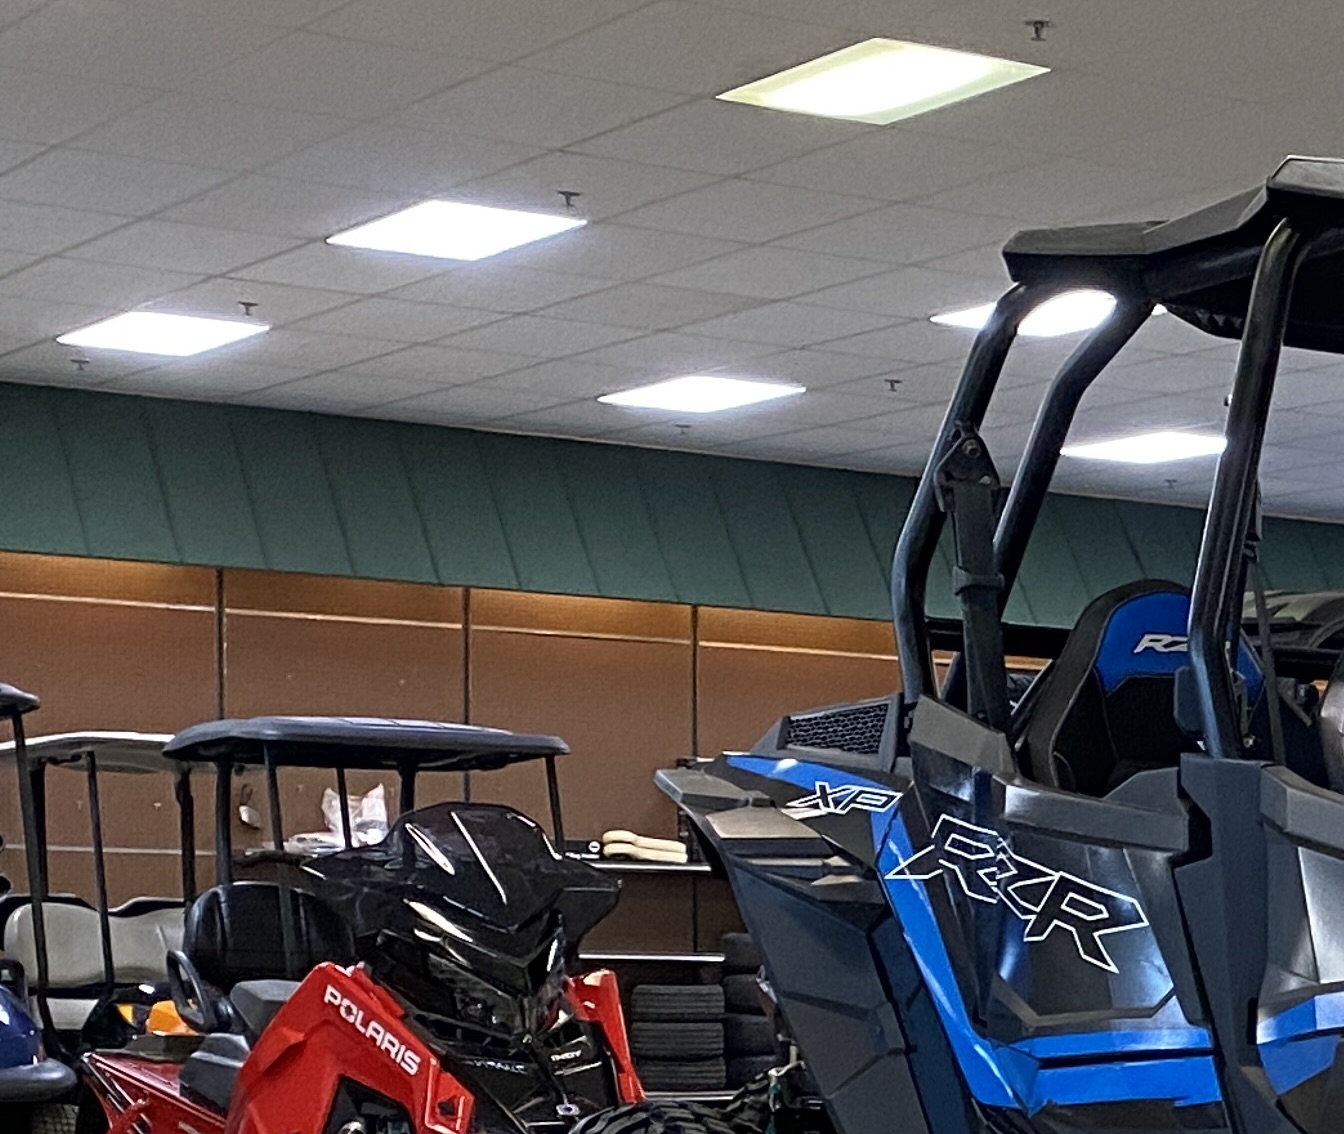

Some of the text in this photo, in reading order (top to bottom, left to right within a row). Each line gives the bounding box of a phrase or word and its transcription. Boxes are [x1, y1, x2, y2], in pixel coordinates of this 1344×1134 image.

[1133, 633, 1190, 654] RZ
[786, 781, 903, 815] XP
[884, 814, 1150, 974] RZR
[323, 984, 421, 1076] POLARIS
